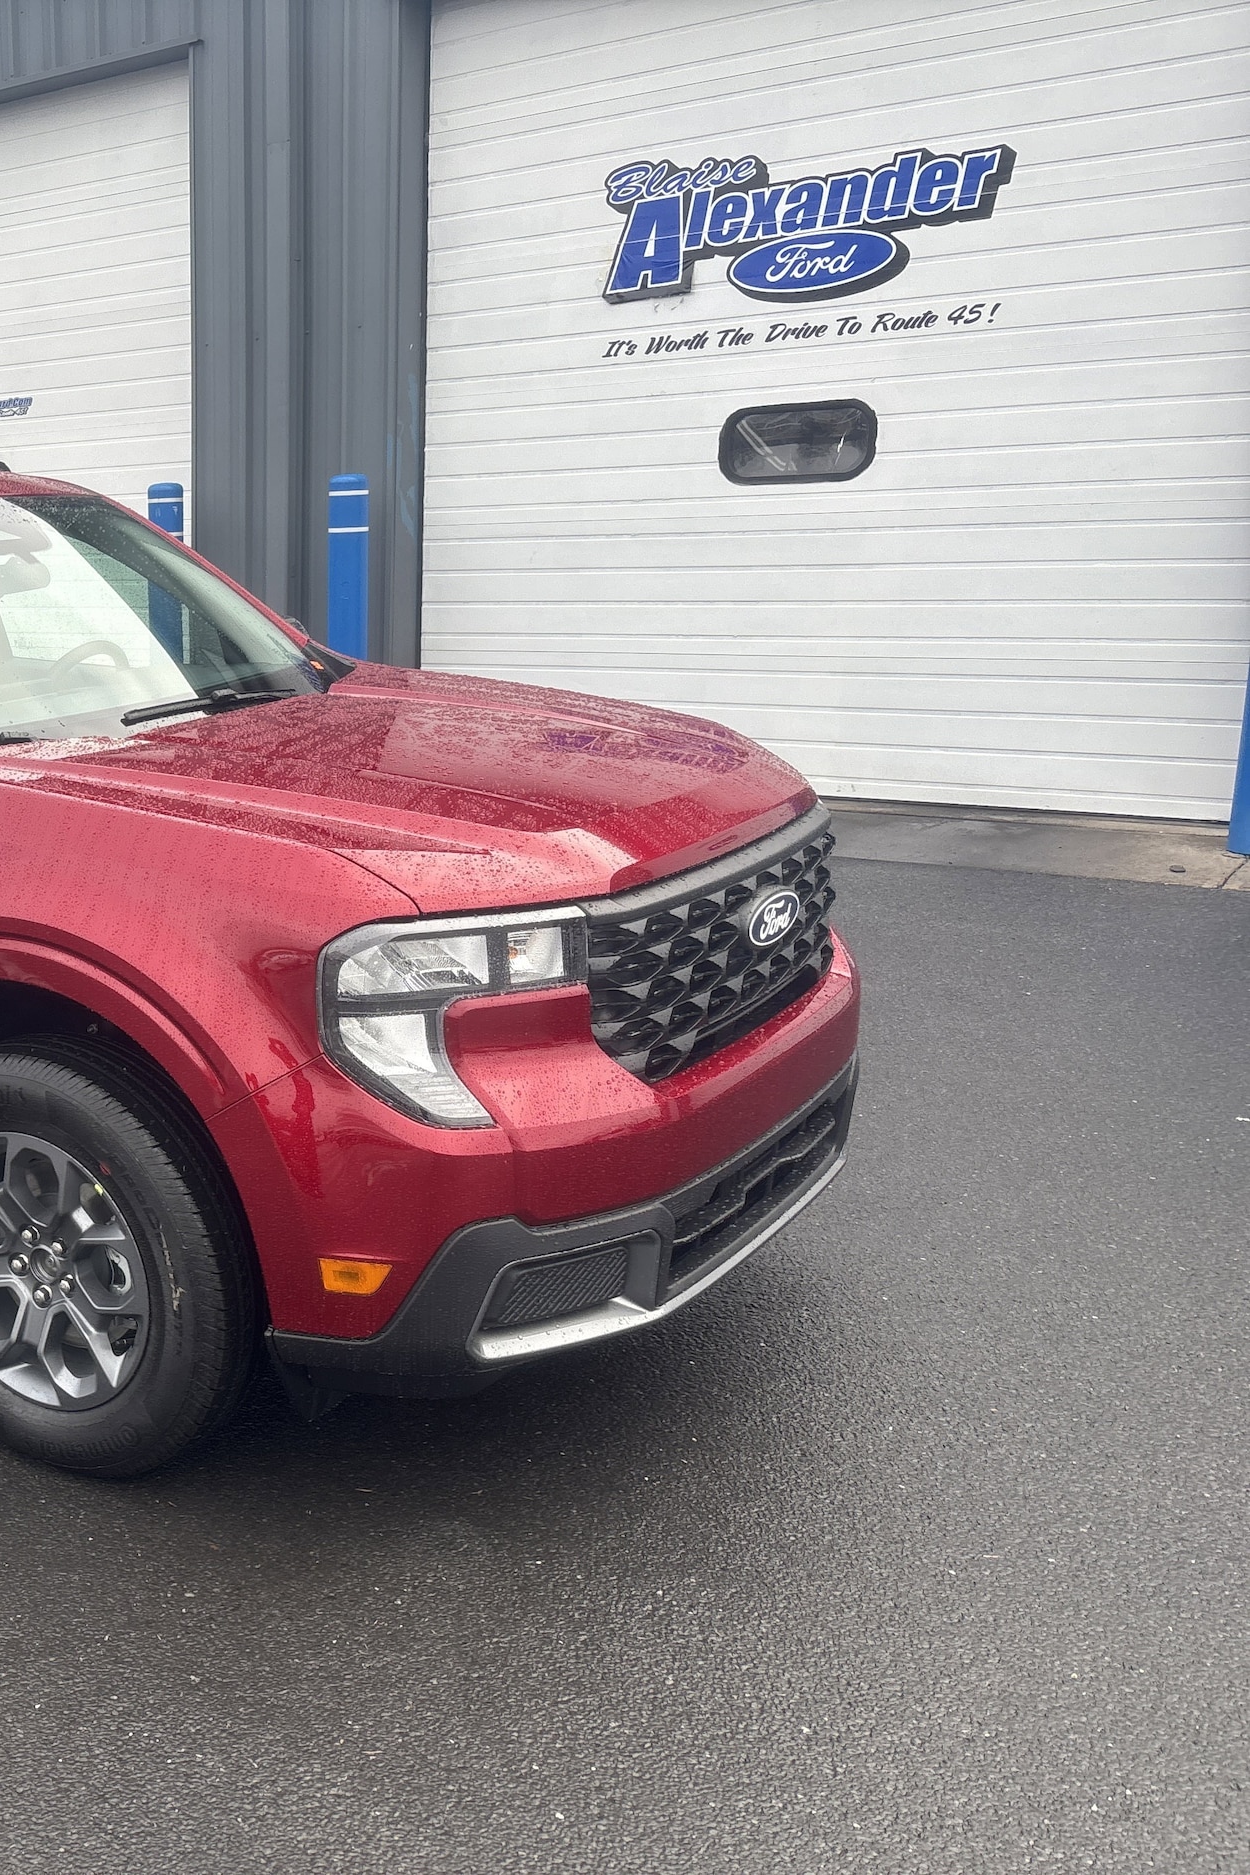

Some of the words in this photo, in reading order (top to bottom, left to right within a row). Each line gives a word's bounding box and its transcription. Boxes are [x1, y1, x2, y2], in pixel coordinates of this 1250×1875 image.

[607, 158, 757, 206] Blaise
[605, 149, 1003, 295] Alexander
[764, 240, 859, 283] Ford
[601, 339, 639, 359] It's
[644, 330, 710, 355] Worth
[716, 327, 755, 348] The
[764, 322, 829, 344] Drive
[836, 315, 863, 336] To
[870, 310, 939, 333] Route
[947, 302, 1002, 326] 45!
[759, 899, 792, 940] Ford
